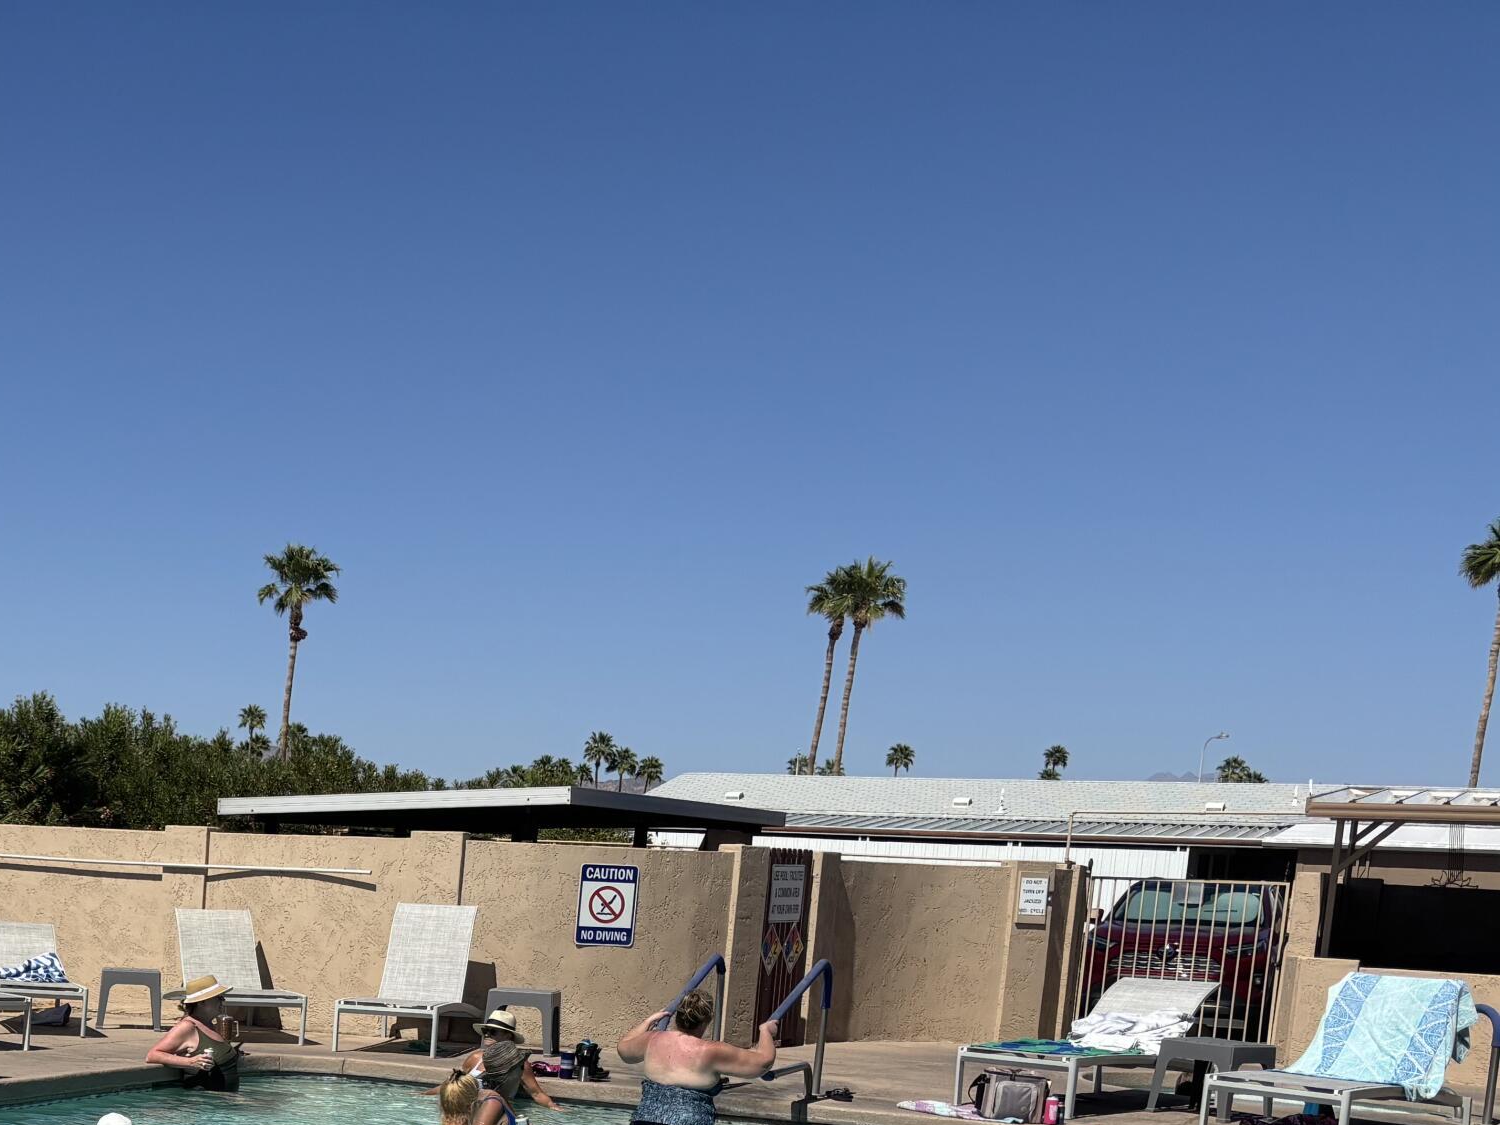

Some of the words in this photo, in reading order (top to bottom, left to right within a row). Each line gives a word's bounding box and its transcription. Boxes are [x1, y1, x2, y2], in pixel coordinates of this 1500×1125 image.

[585, 867, 634, 881] CAUTION
[580, 930, 594, 940] NO
[595, 931, 627, 942] DIVING
